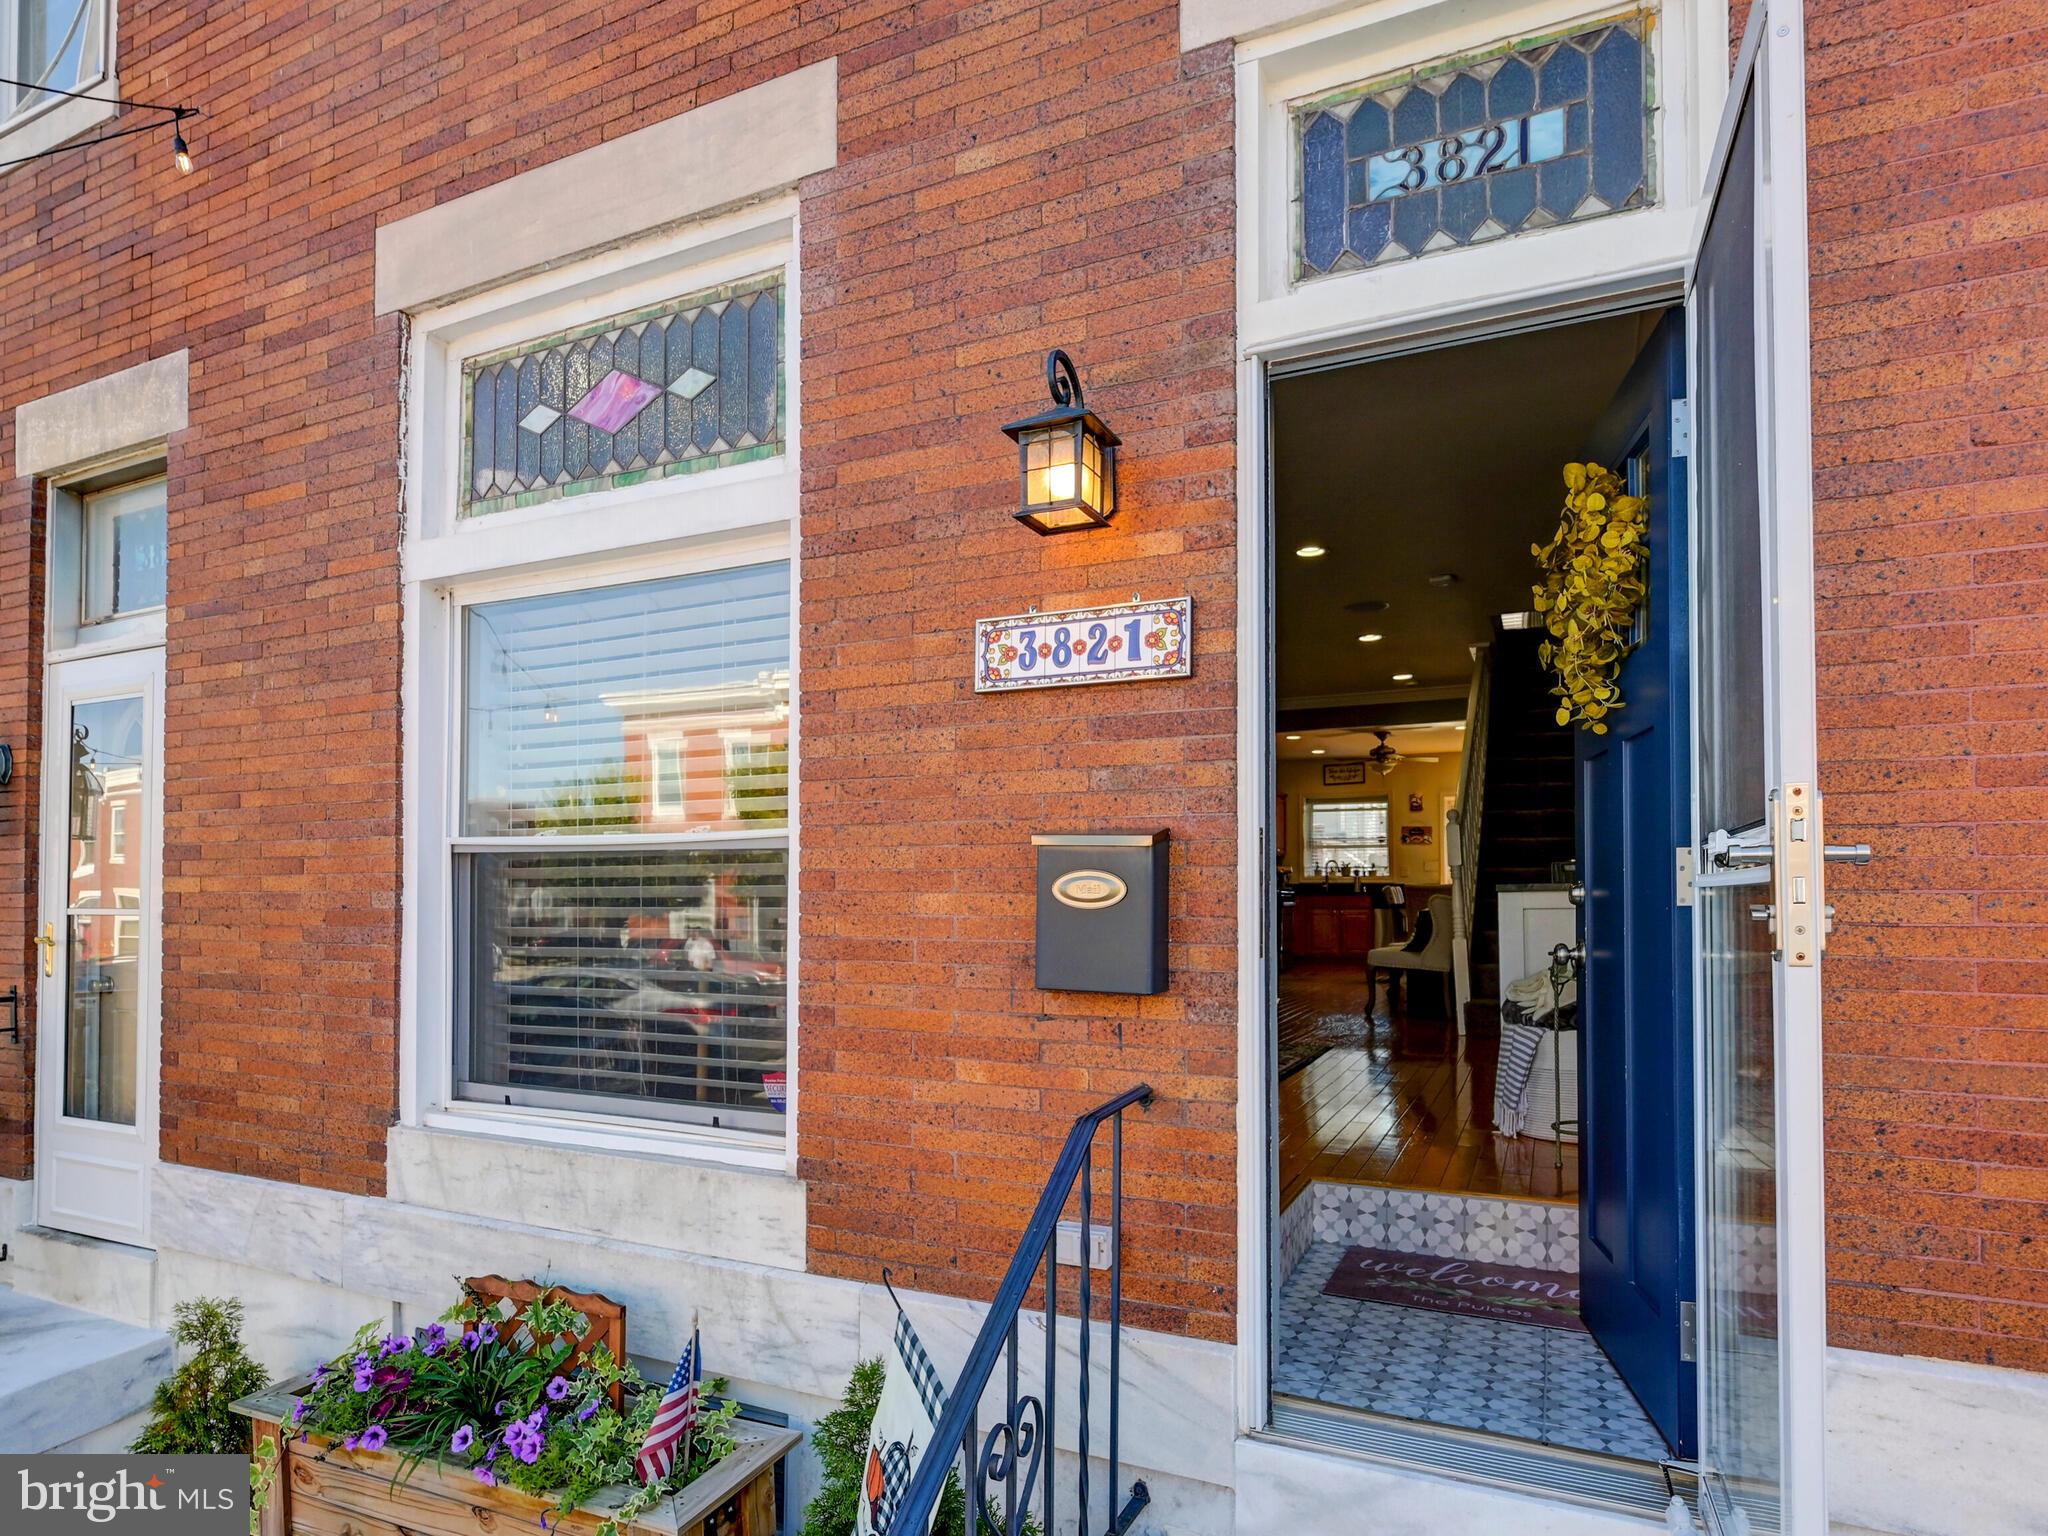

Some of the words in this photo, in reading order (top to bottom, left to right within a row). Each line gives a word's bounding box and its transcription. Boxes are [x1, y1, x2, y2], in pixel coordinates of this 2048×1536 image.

[1376, 116, 1529, 200] 3821
[1018, 618, 1142, 672] 3821
[1412, 1294, 1449, 1306] The
